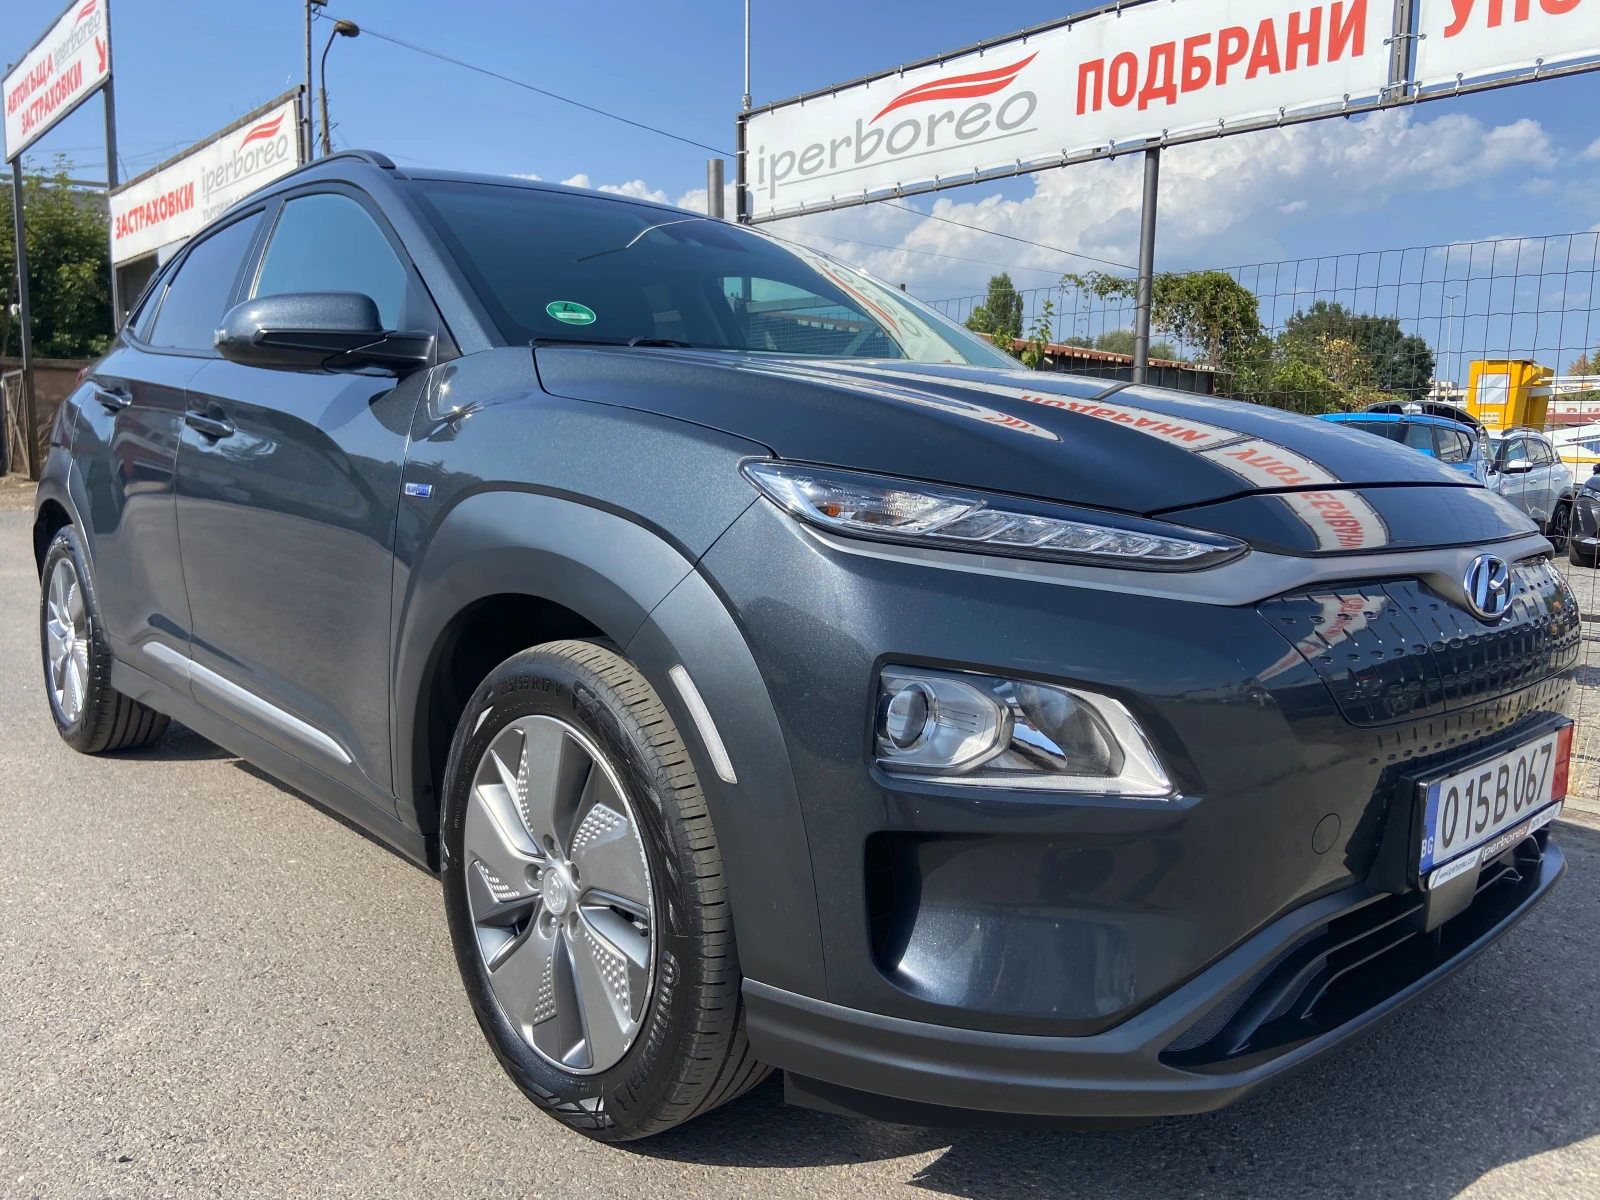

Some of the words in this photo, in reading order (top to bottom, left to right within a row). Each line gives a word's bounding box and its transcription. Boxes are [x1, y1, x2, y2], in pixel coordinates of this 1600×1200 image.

[7, 53, 54, 117] АВТОКЪЩА
[53, 9, 101, 75] iperboreo
[21, 60, 82, 136] ЗАСТРАХОВКИ
[1076, 0, 1368, 116] ПОДБРАНИ
[116, 182, 194, 240] ЗАСТРАХОВКИ
[202, 134, 289, 204] iperboreo
[757, 90, 1038, 200] iperboreo
[1421, 836, 1434, 858] BG
[1441, 742, 1553, 848] 015B067
[1481, 825, 1528, 861] iperboreo
